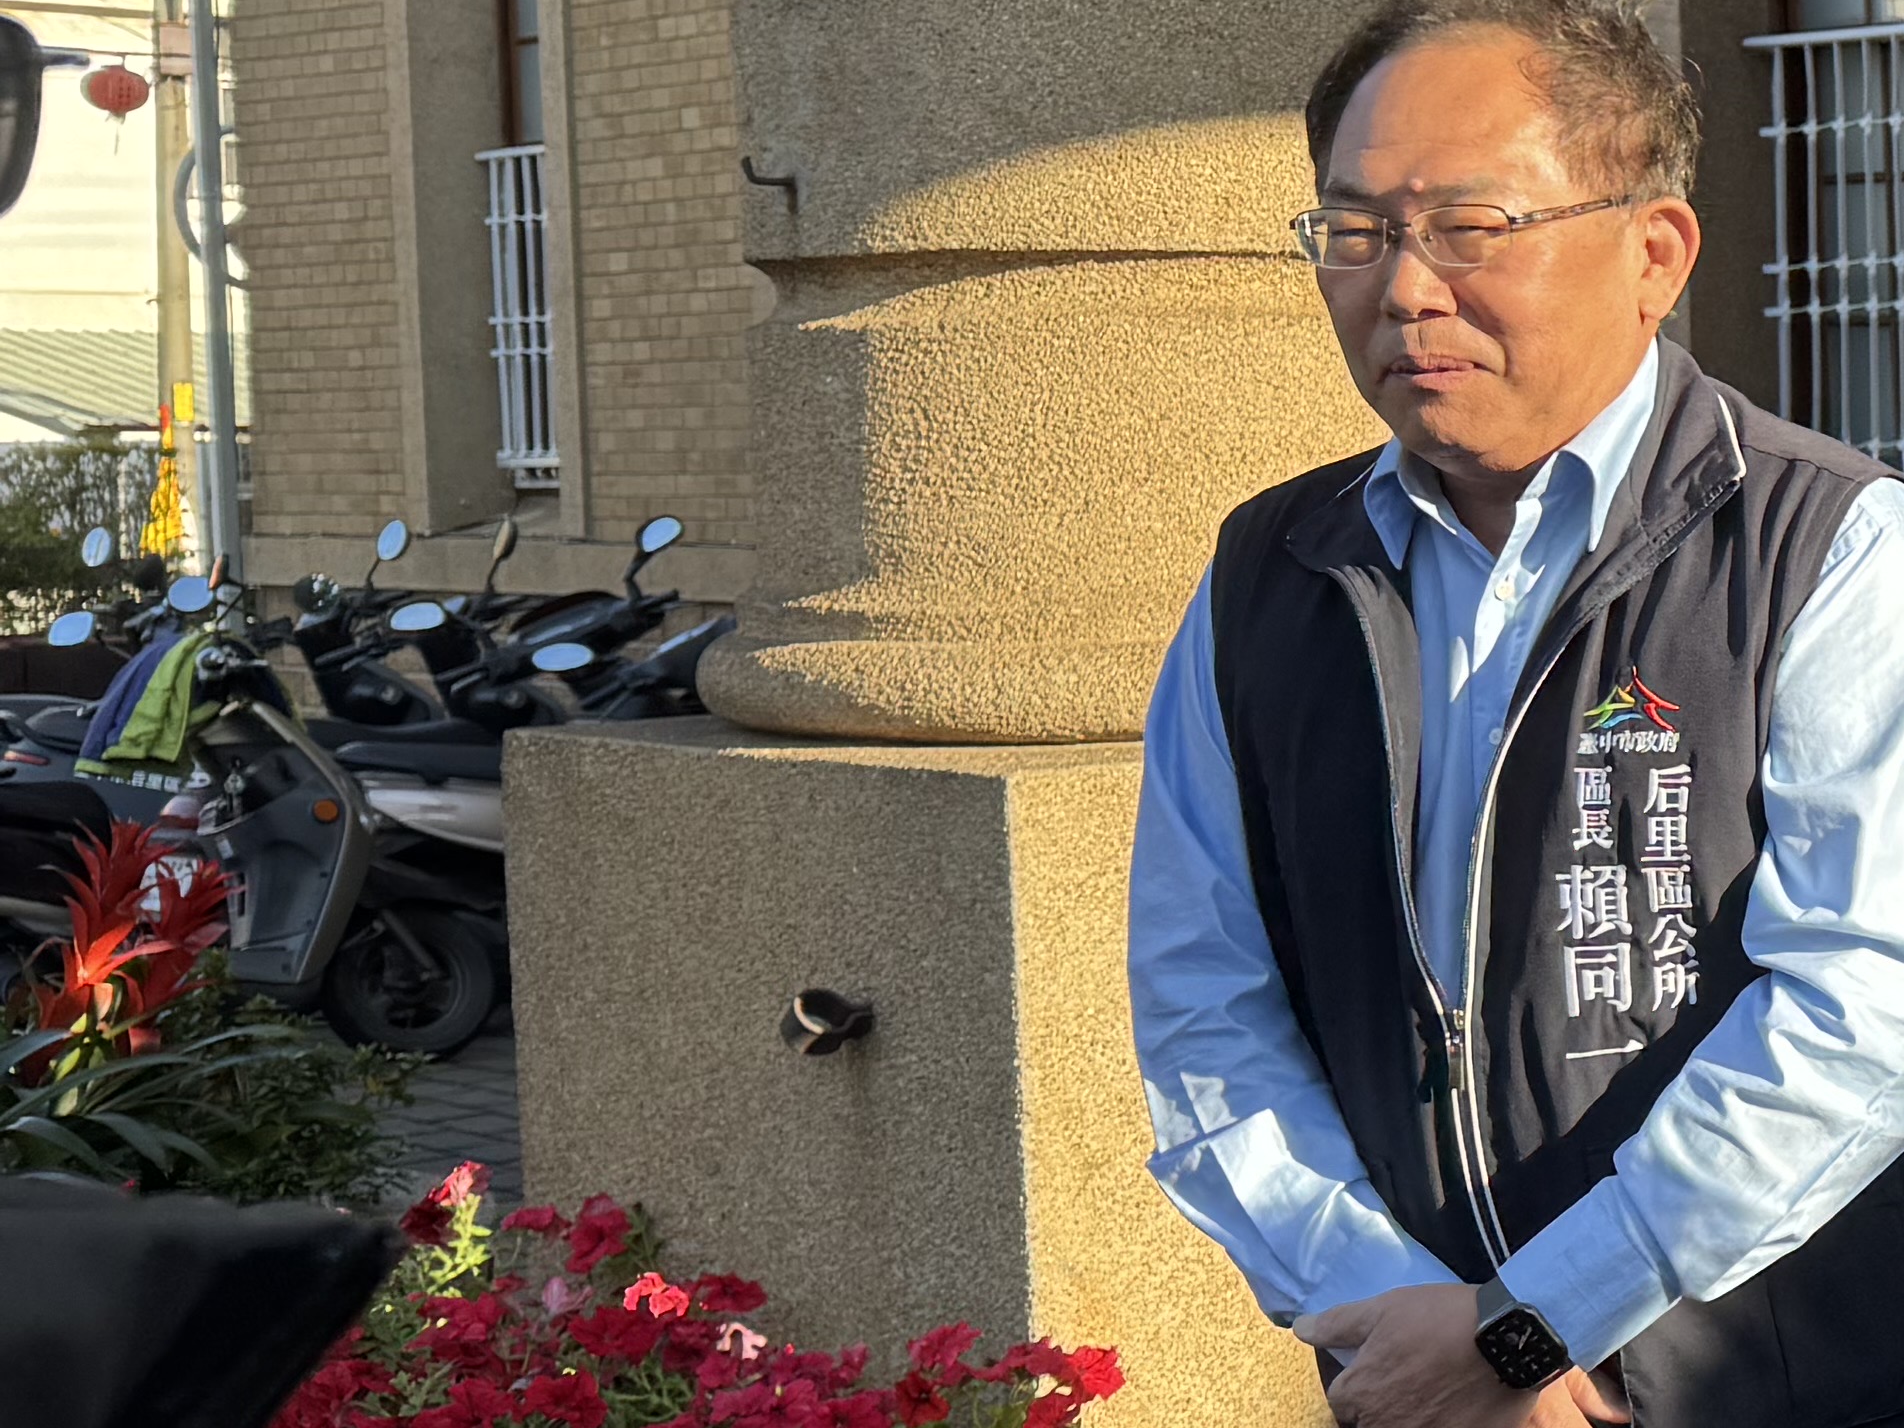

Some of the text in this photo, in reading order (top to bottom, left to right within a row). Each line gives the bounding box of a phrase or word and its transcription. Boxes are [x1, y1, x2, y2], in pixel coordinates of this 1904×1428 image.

[1555, 764, 1645, 1060] 區長 賴同一
[1641, 763, 1700, 1012] 后里區公所
